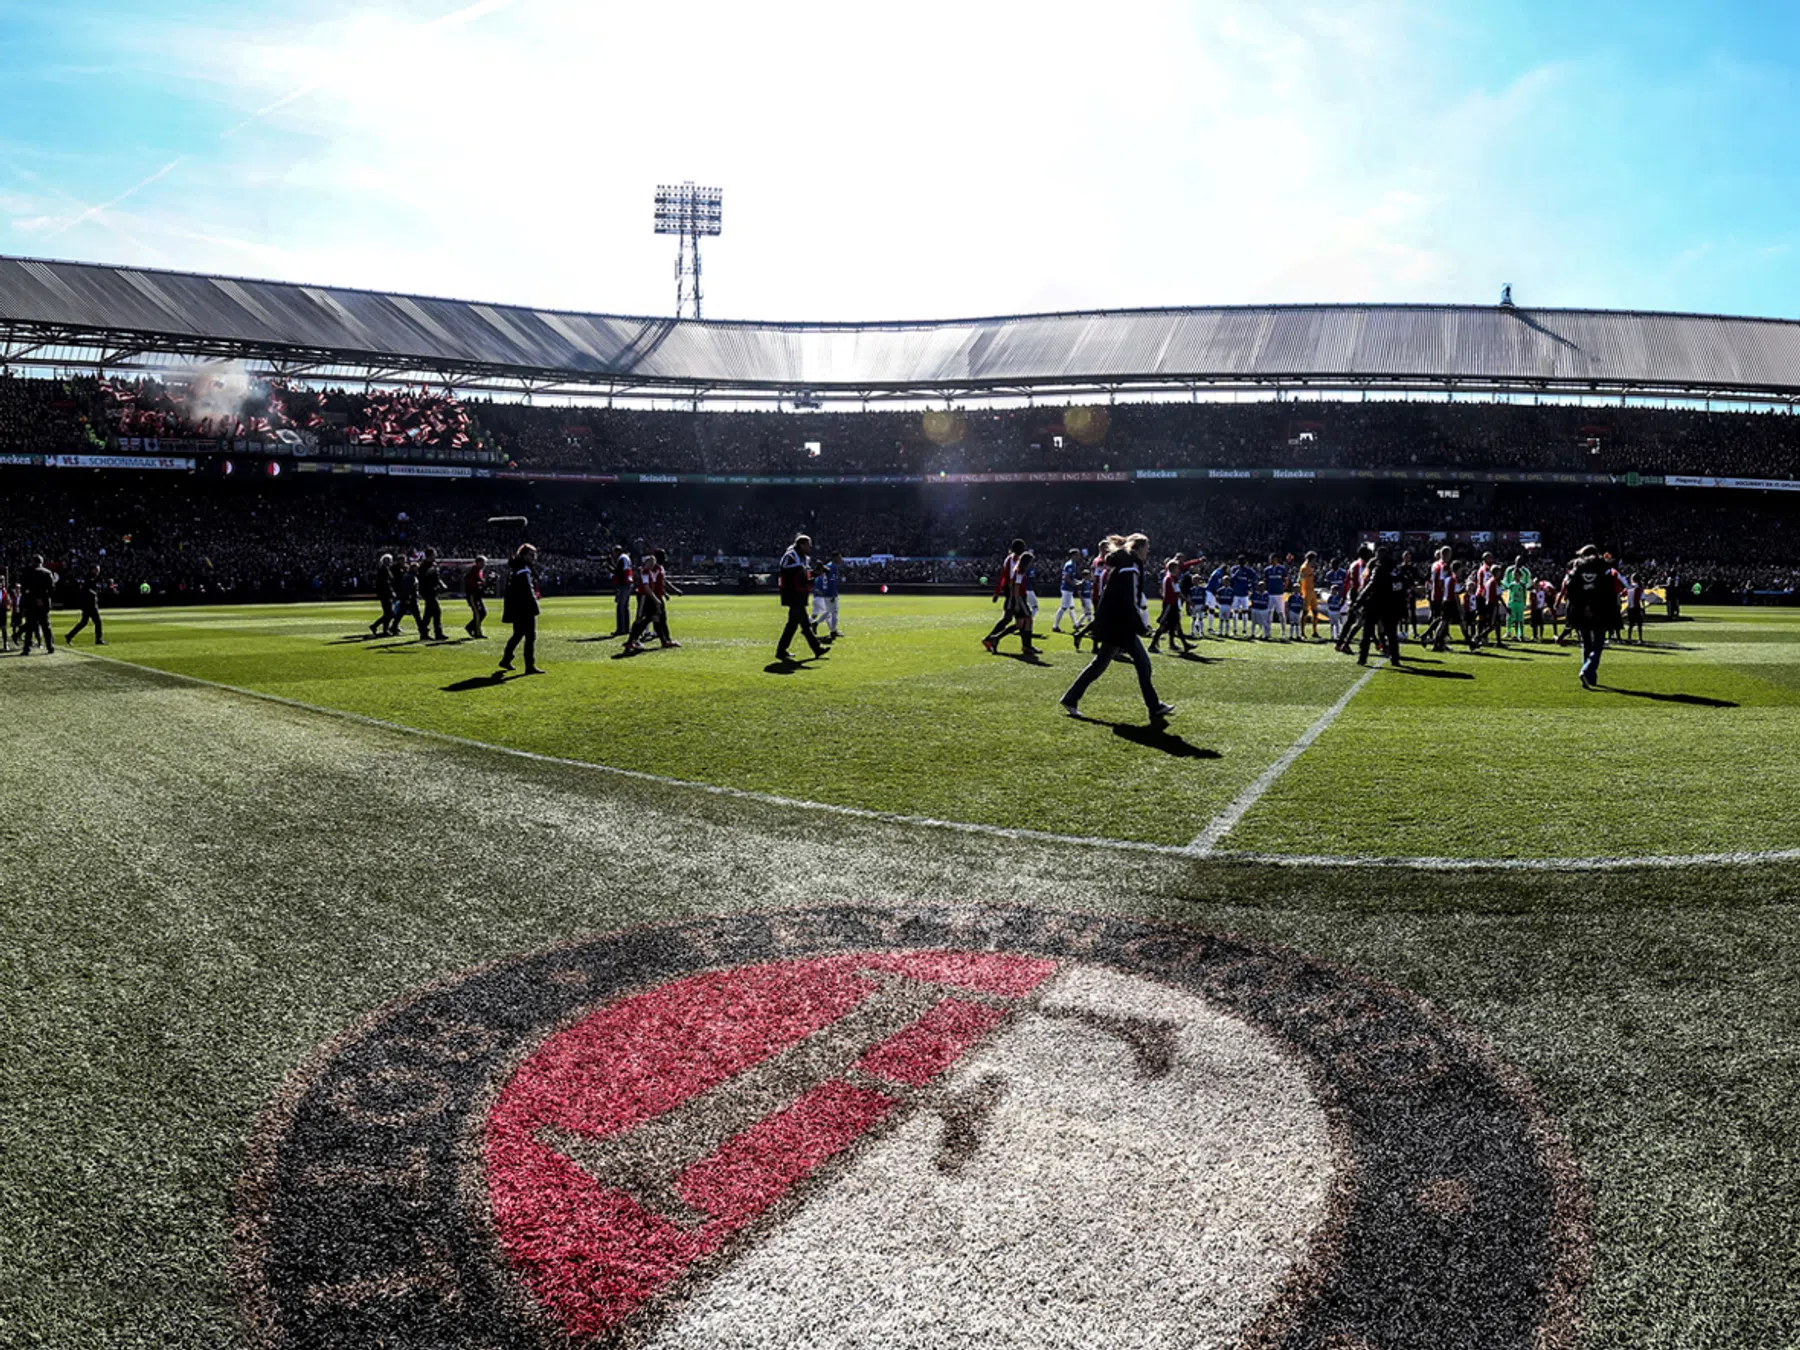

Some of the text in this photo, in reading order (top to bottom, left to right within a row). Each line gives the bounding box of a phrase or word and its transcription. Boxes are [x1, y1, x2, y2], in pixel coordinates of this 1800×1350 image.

[0, 455, 31, 465] neken
[1136, 470, 1178, 478] Heineken
[1208, 470, 1251, 478] Heineken
[1273, 470, 1316, 478] Heineken
[638, 474, 678, 483] Heineken
